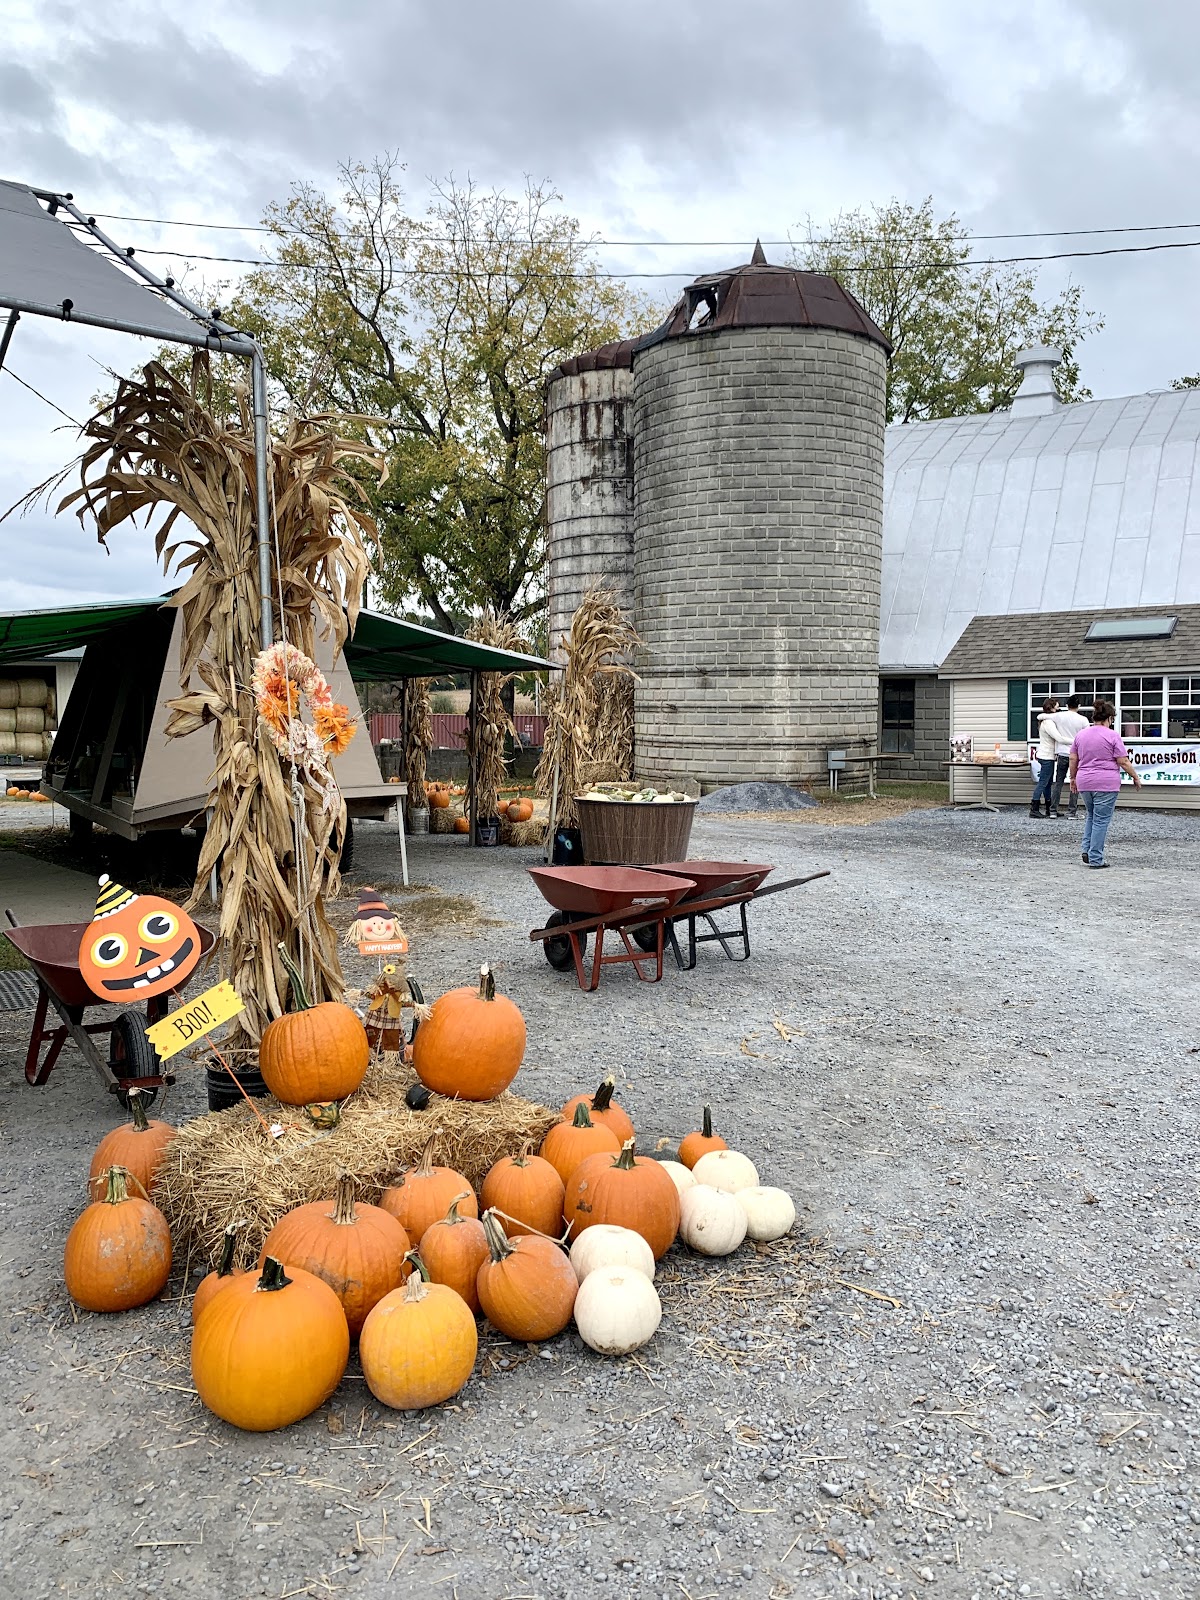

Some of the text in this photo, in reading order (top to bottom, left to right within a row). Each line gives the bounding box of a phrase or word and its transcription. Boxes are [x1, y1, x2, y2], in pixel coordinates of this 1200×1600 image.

[1127, 748, 1197, 765] Concession
[1156, 771, 1192, 781] Farm
[172, 1000, 217, 1041] BOO!
